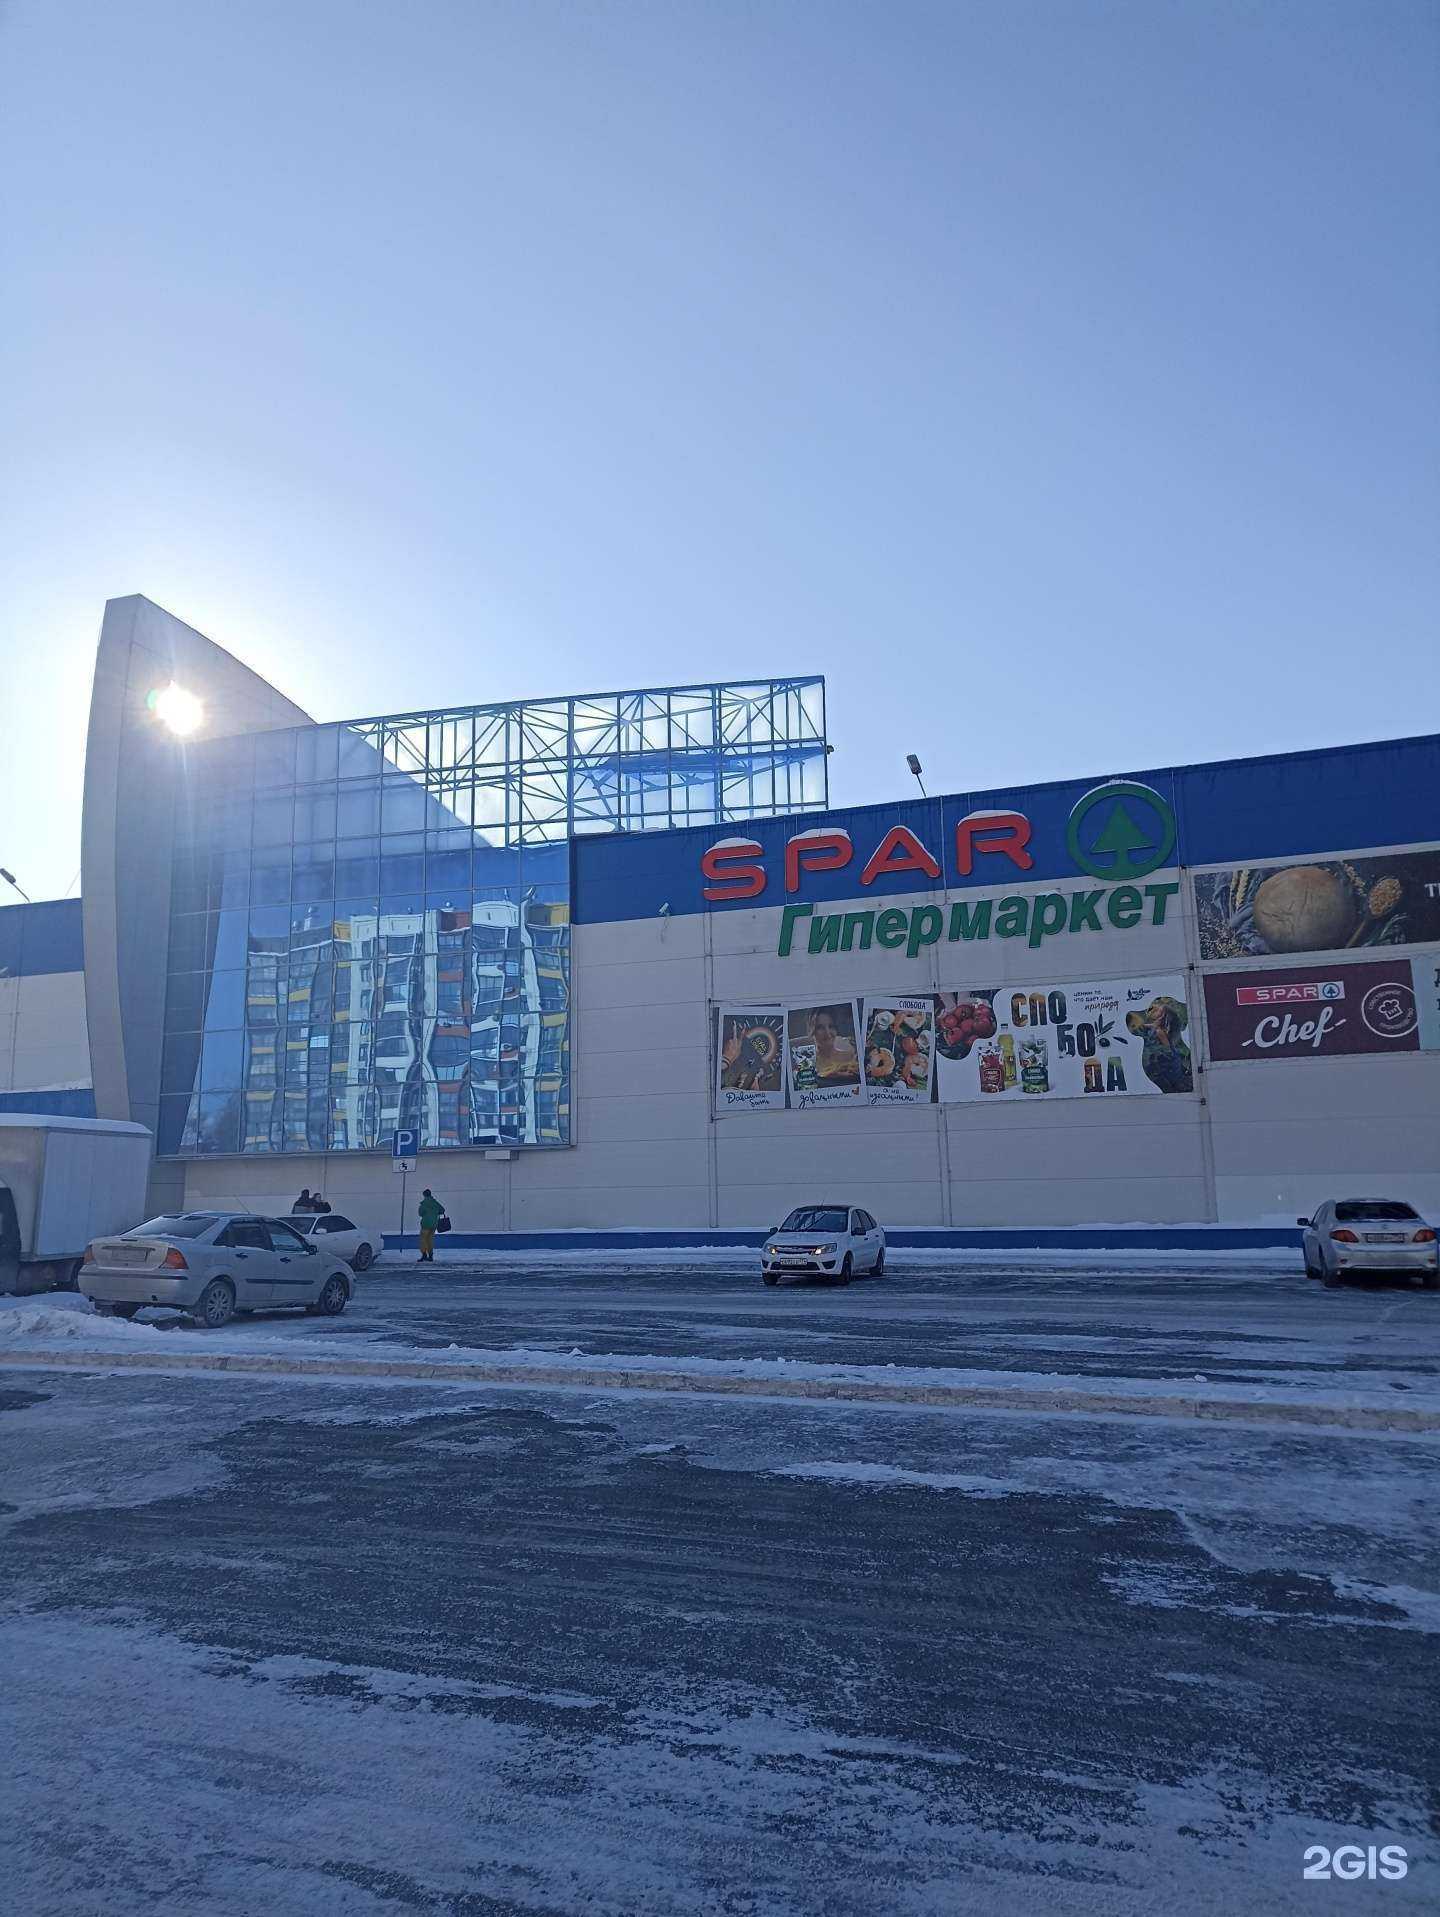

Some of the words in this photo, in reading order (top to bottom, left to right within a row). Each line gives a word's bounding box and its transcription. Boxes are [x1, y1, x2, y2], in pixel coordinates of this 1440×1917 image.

[701, 812, 1034, 900] SPAR
[778, 883, 1179, 957] Гипермаркет
[1256, 986, 1318, 1001] SPAR
[1252, 1006, 1336, 1048] Chef
[397, 1130, 414, 1155] P
